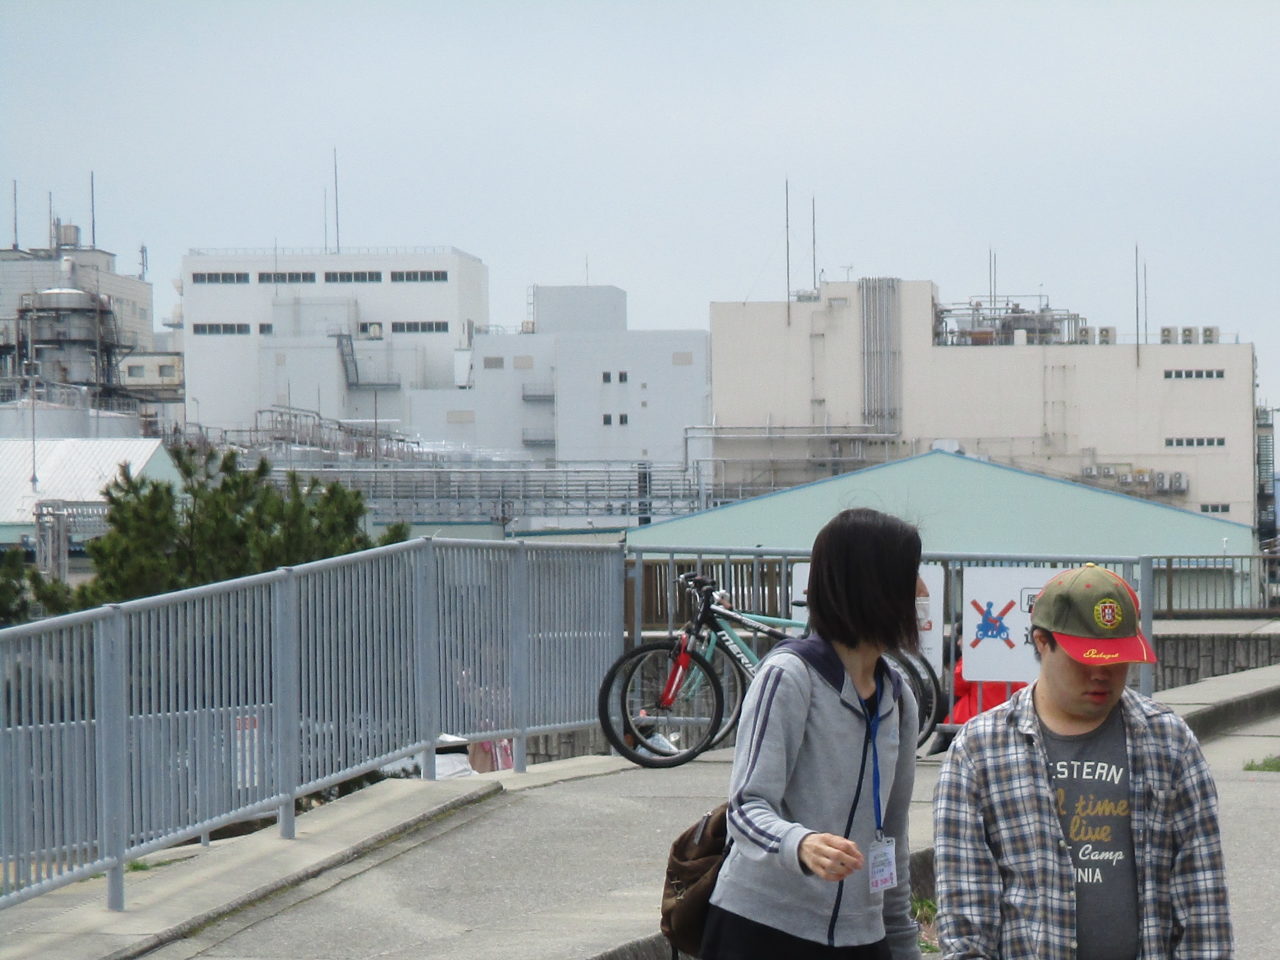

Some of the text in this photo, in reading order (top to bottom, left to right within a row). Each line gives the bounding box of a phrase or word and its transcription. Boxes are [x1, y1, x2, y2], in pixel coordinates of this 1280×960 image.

[1049, 761, 1124, 785] STERN
[1075, 793, 1130, 816] time
[1079, 844, 1125, 866] Camp
